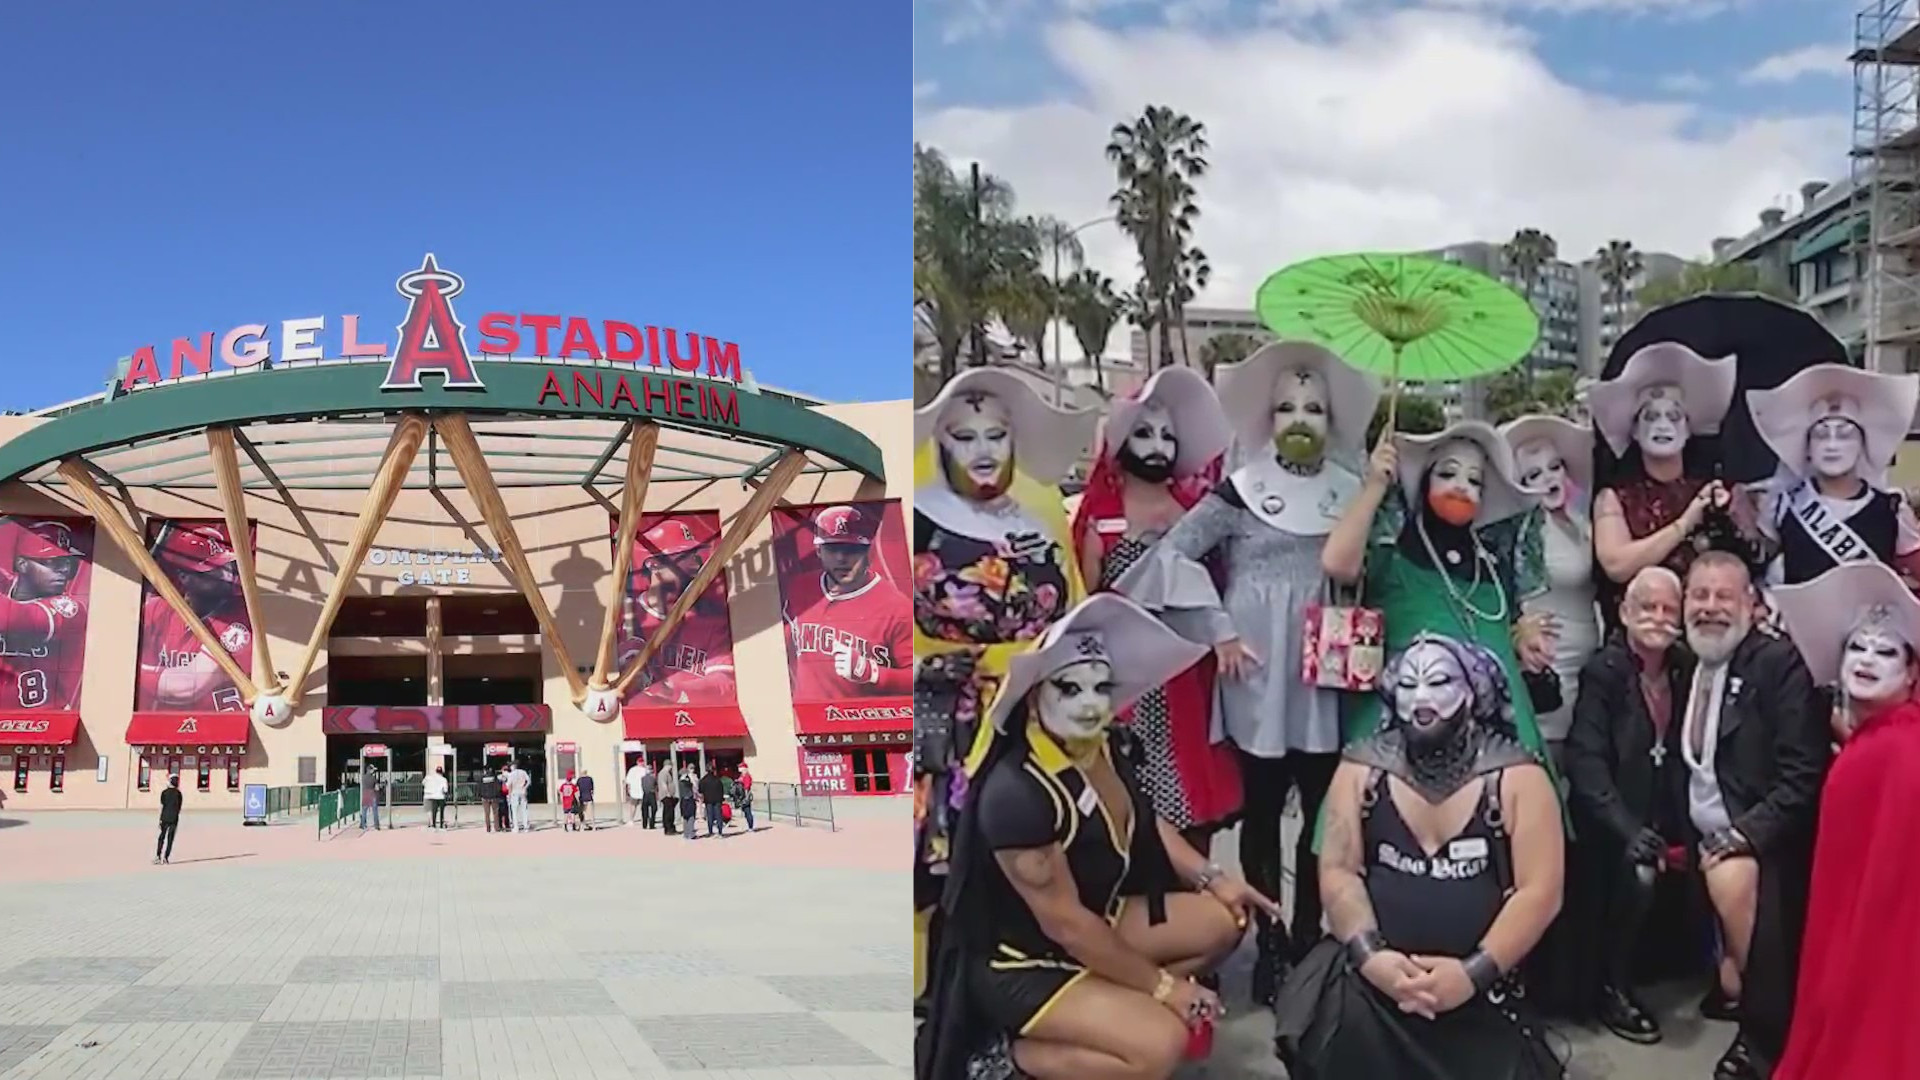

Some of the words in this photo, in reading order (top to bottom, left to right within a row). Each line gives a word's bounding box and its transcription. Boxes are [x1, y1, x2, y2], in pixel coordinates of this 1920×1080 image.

[122, 315, 388, 390] ANGEL
[477, 311, 743, 383] STADIUM
[537, 370, 741, 427] ANAHEIM
[398, 568, 471, 585] GATE
[17, 669, 48, 708] 8
[264, 702, 275, 718] A
[597, 699, 607, 713] A
[796, 733, 853, 744] TEAM
[14, 745, 65, 755] CALL
[131, 745, 183, 755] WILL
[197, 745, 247, 755] CALL
[804, 779, 848, 792] STORE
